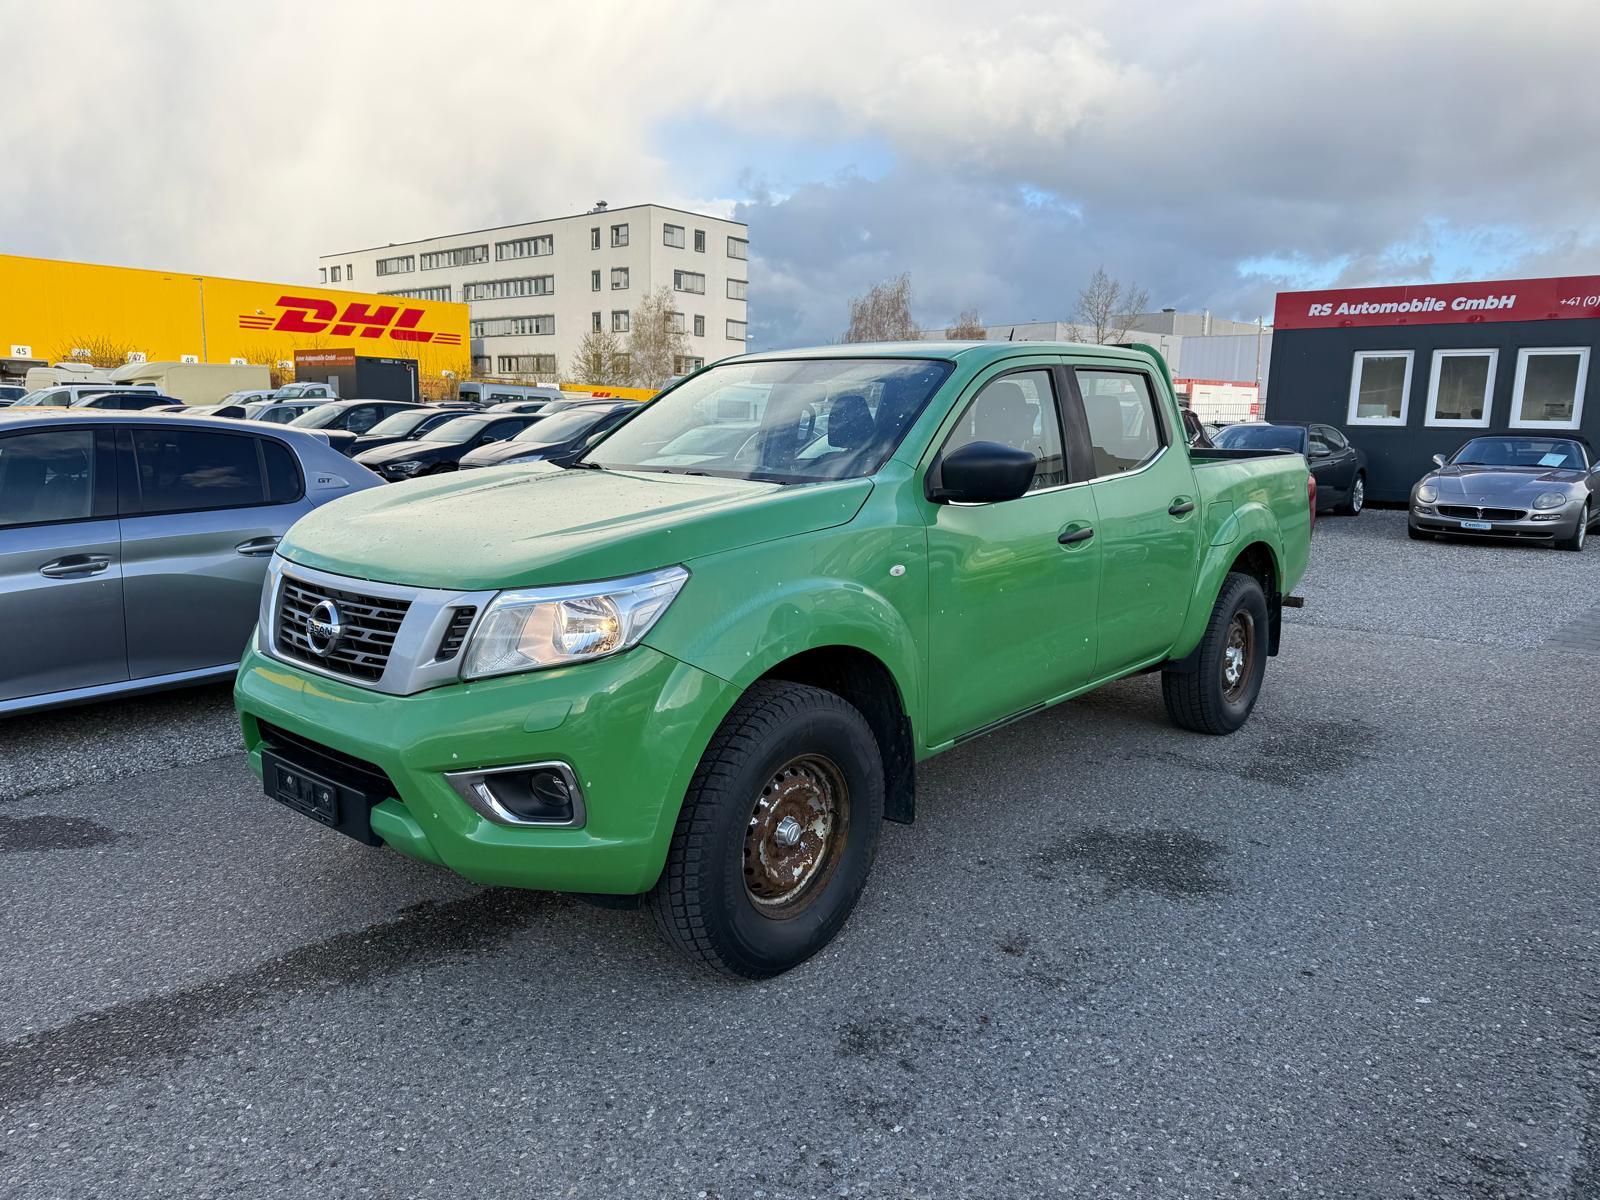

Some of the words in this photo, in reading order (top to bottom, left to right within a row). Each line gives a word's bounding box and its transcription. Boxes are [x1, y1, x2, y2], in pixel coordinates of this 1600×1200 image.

[1308, 302, 1333, 317] RS
[1335, 297, 1447, 316] Automobile
[1451, 294, 1517, 311] GmbH
[1559, 296, 1581, 306] +41
[273, 295, 435, 343] DHL
[15, 347, 27, 355] 45
[307, 619, 333, 636] SSAN
